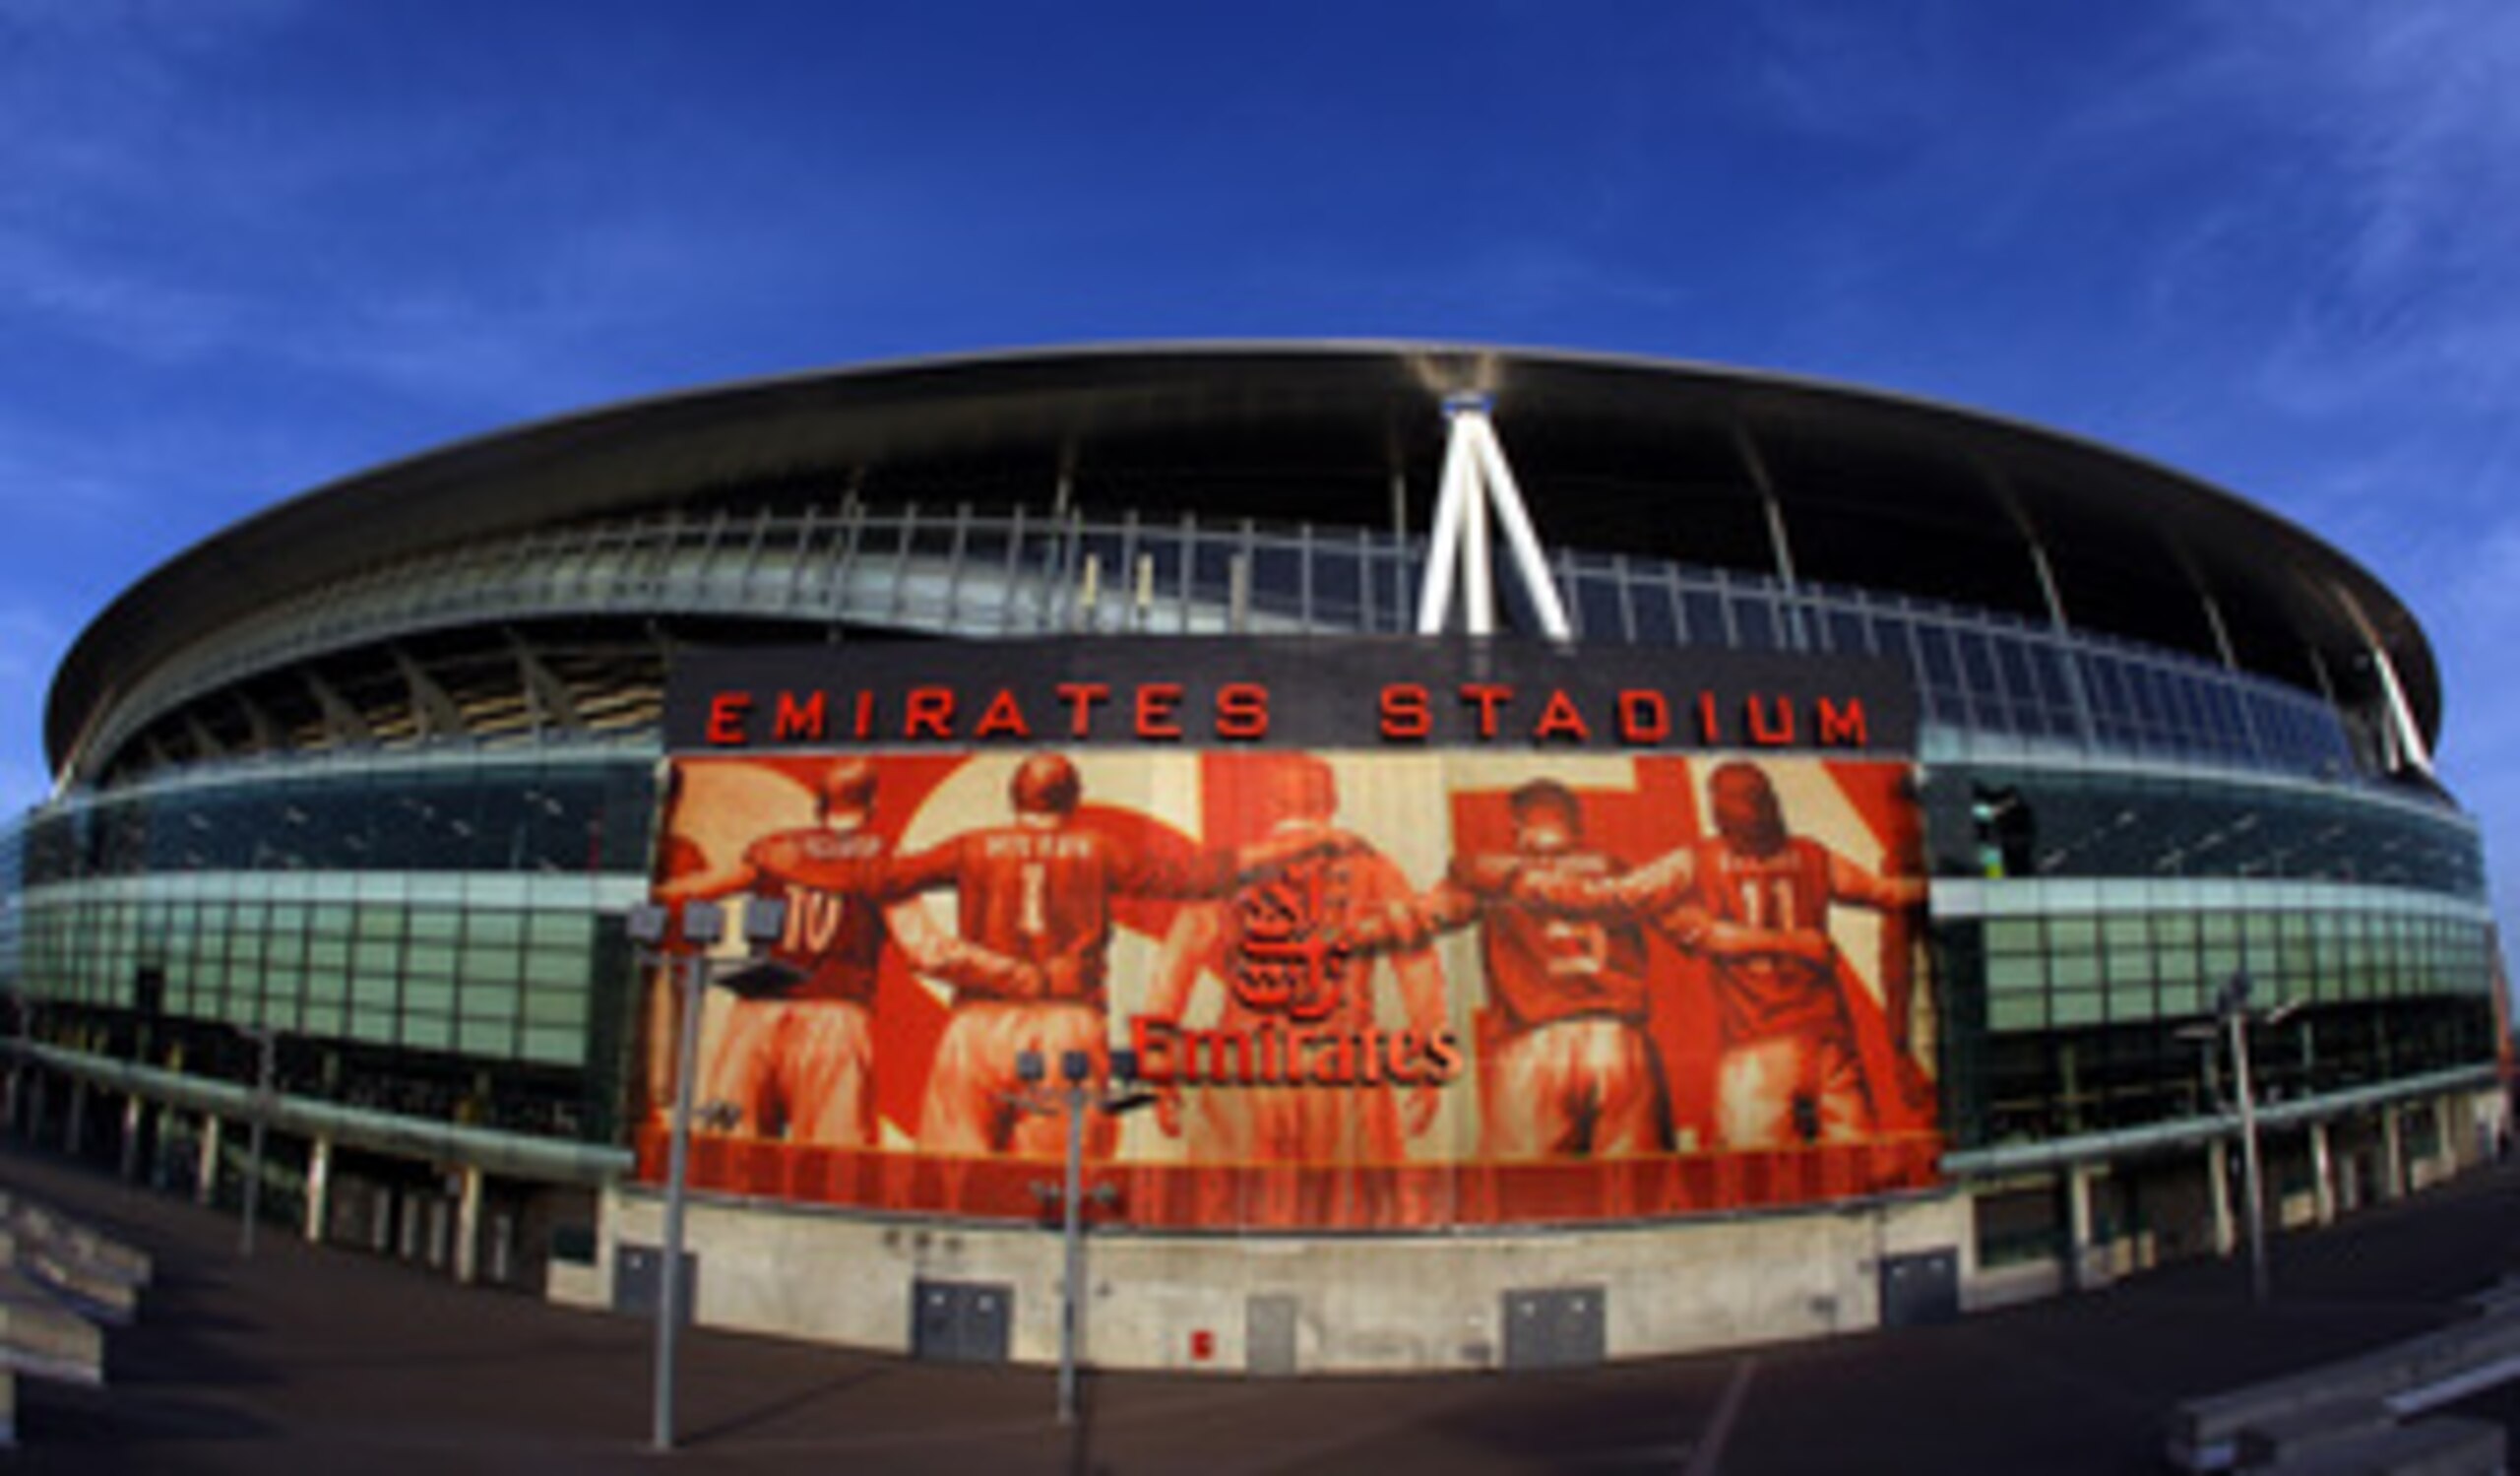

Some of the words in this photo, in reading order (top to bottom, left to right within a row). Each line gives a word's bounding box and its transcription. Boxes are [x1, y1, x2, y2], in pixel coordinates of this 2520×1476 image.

[706, 683, 1270, 742] EMIRATES
[1380, 683, 1867, 743] STADIUM
[1128, 1015, 1464, 1085] Emirates
